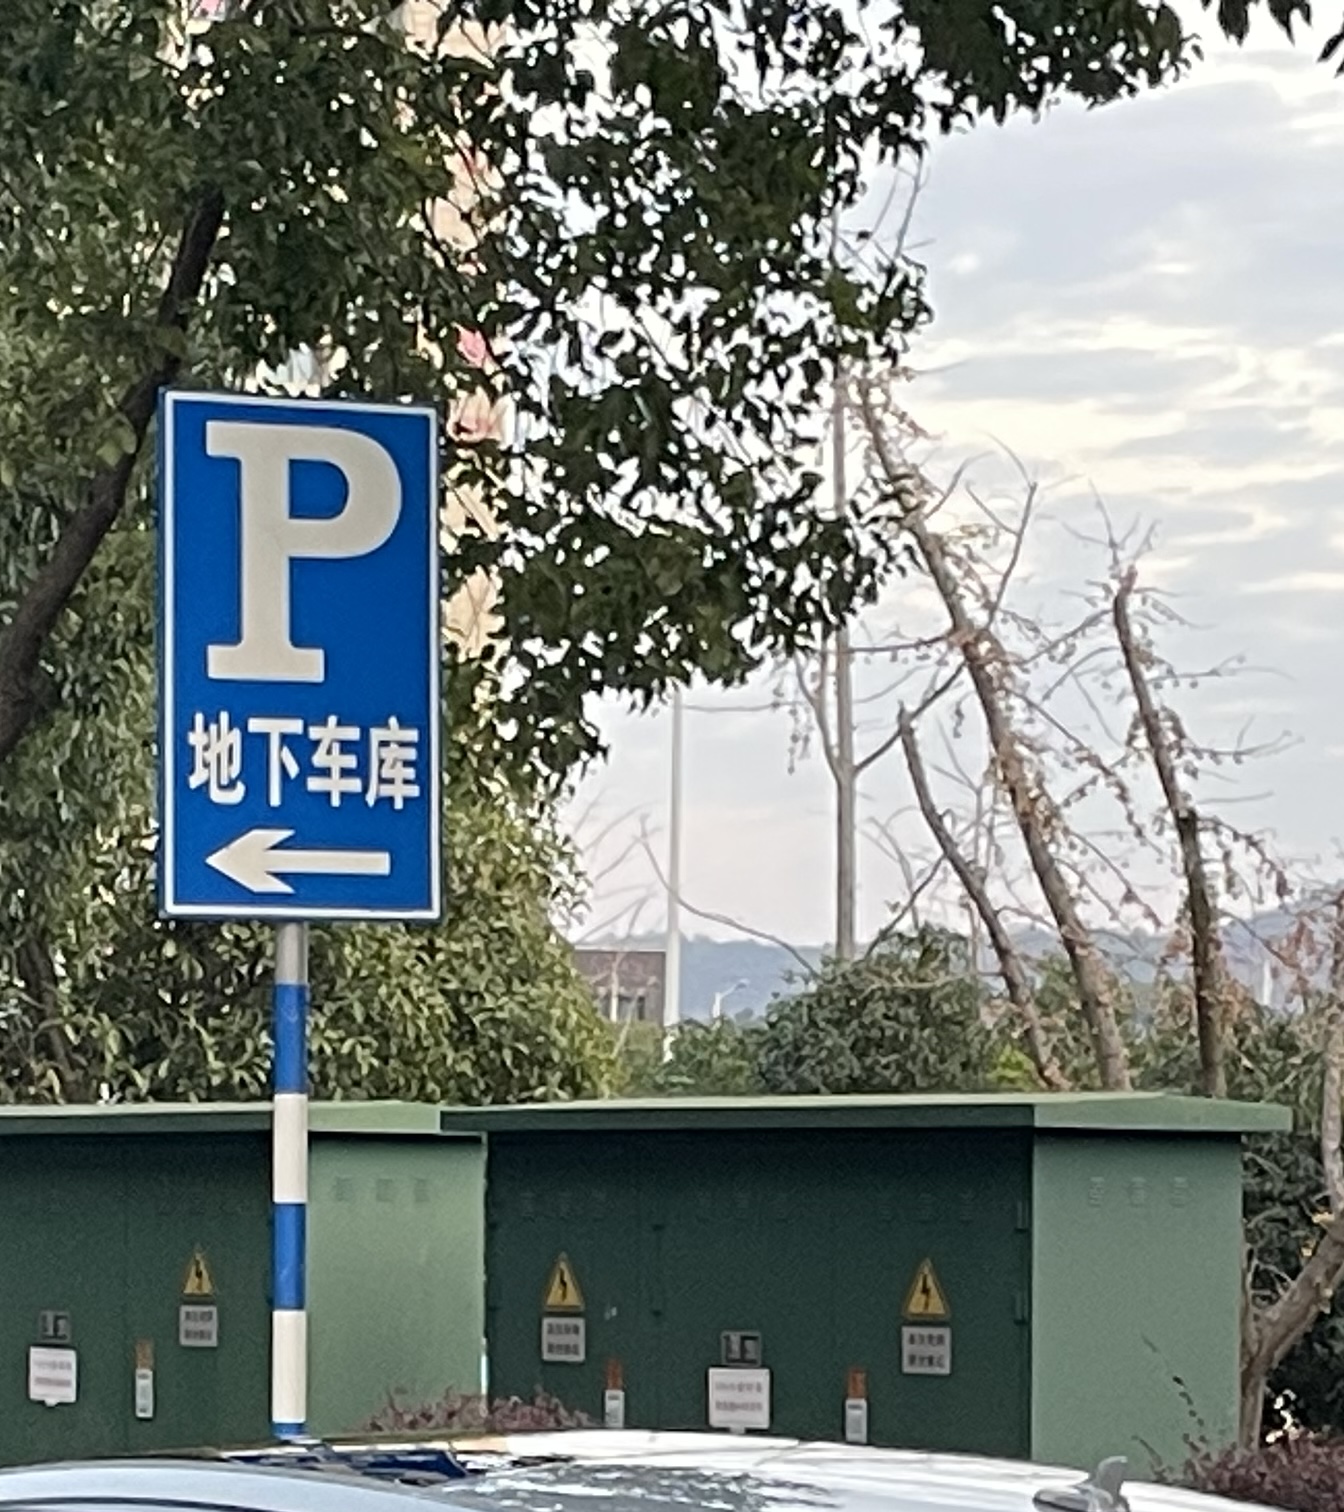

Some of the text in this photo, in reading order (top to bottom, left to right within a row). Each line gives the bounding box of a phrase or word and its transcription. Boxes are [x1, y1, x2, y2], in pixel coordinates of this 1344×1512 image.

[205, 420, 403, 683] P
[187, 711, 420, 809] 地下车库
